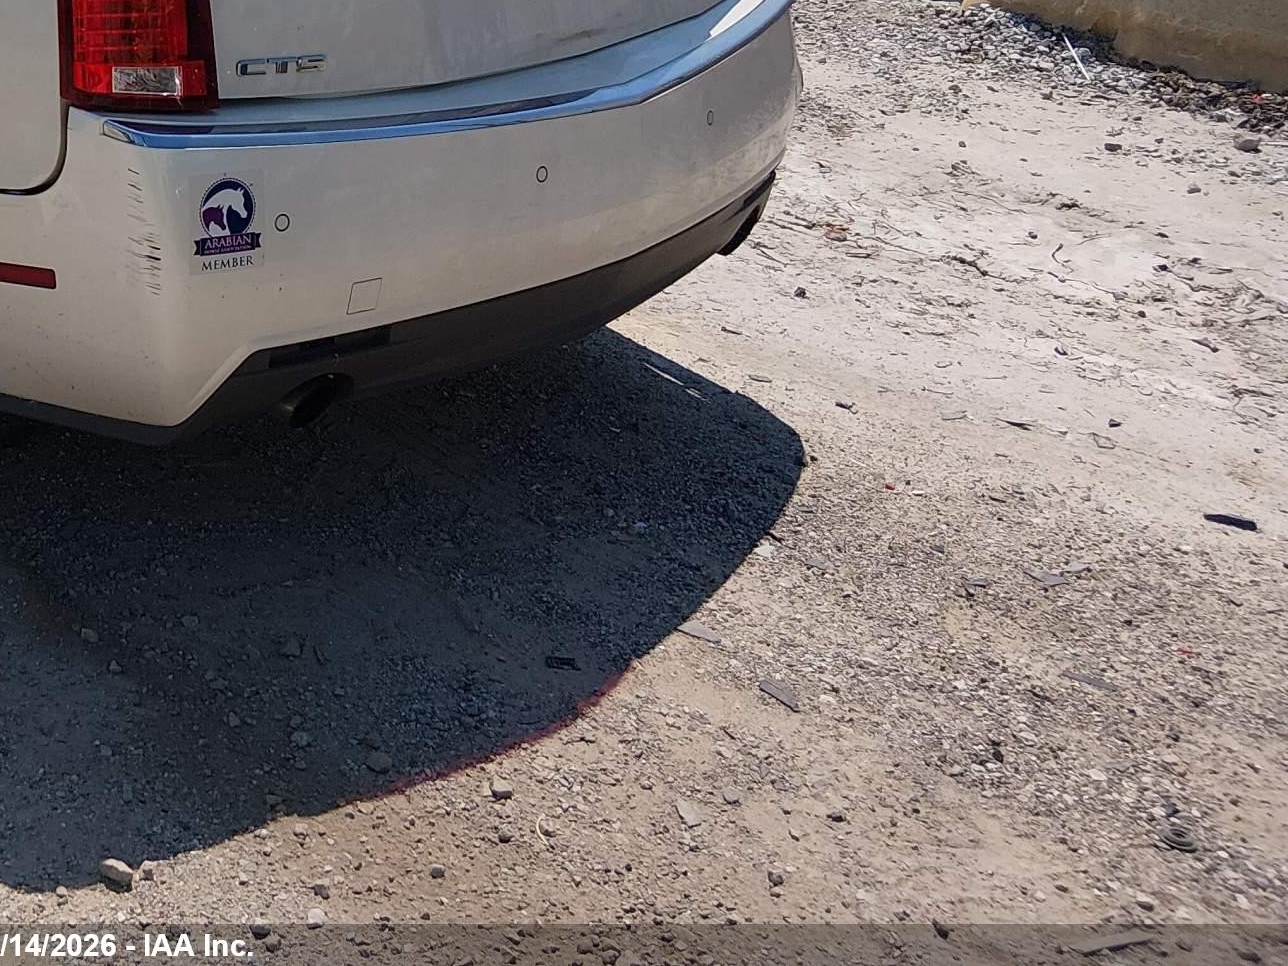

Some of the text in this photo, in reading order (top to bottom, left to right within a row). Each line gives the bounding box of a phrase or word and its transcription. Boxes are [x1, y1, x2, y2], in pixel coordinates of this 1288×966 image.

[235, 54, 327, 77] CTS
[204, 234, 252, 249] ARABIAN
[201, 255, 255, 271] MEMBER
